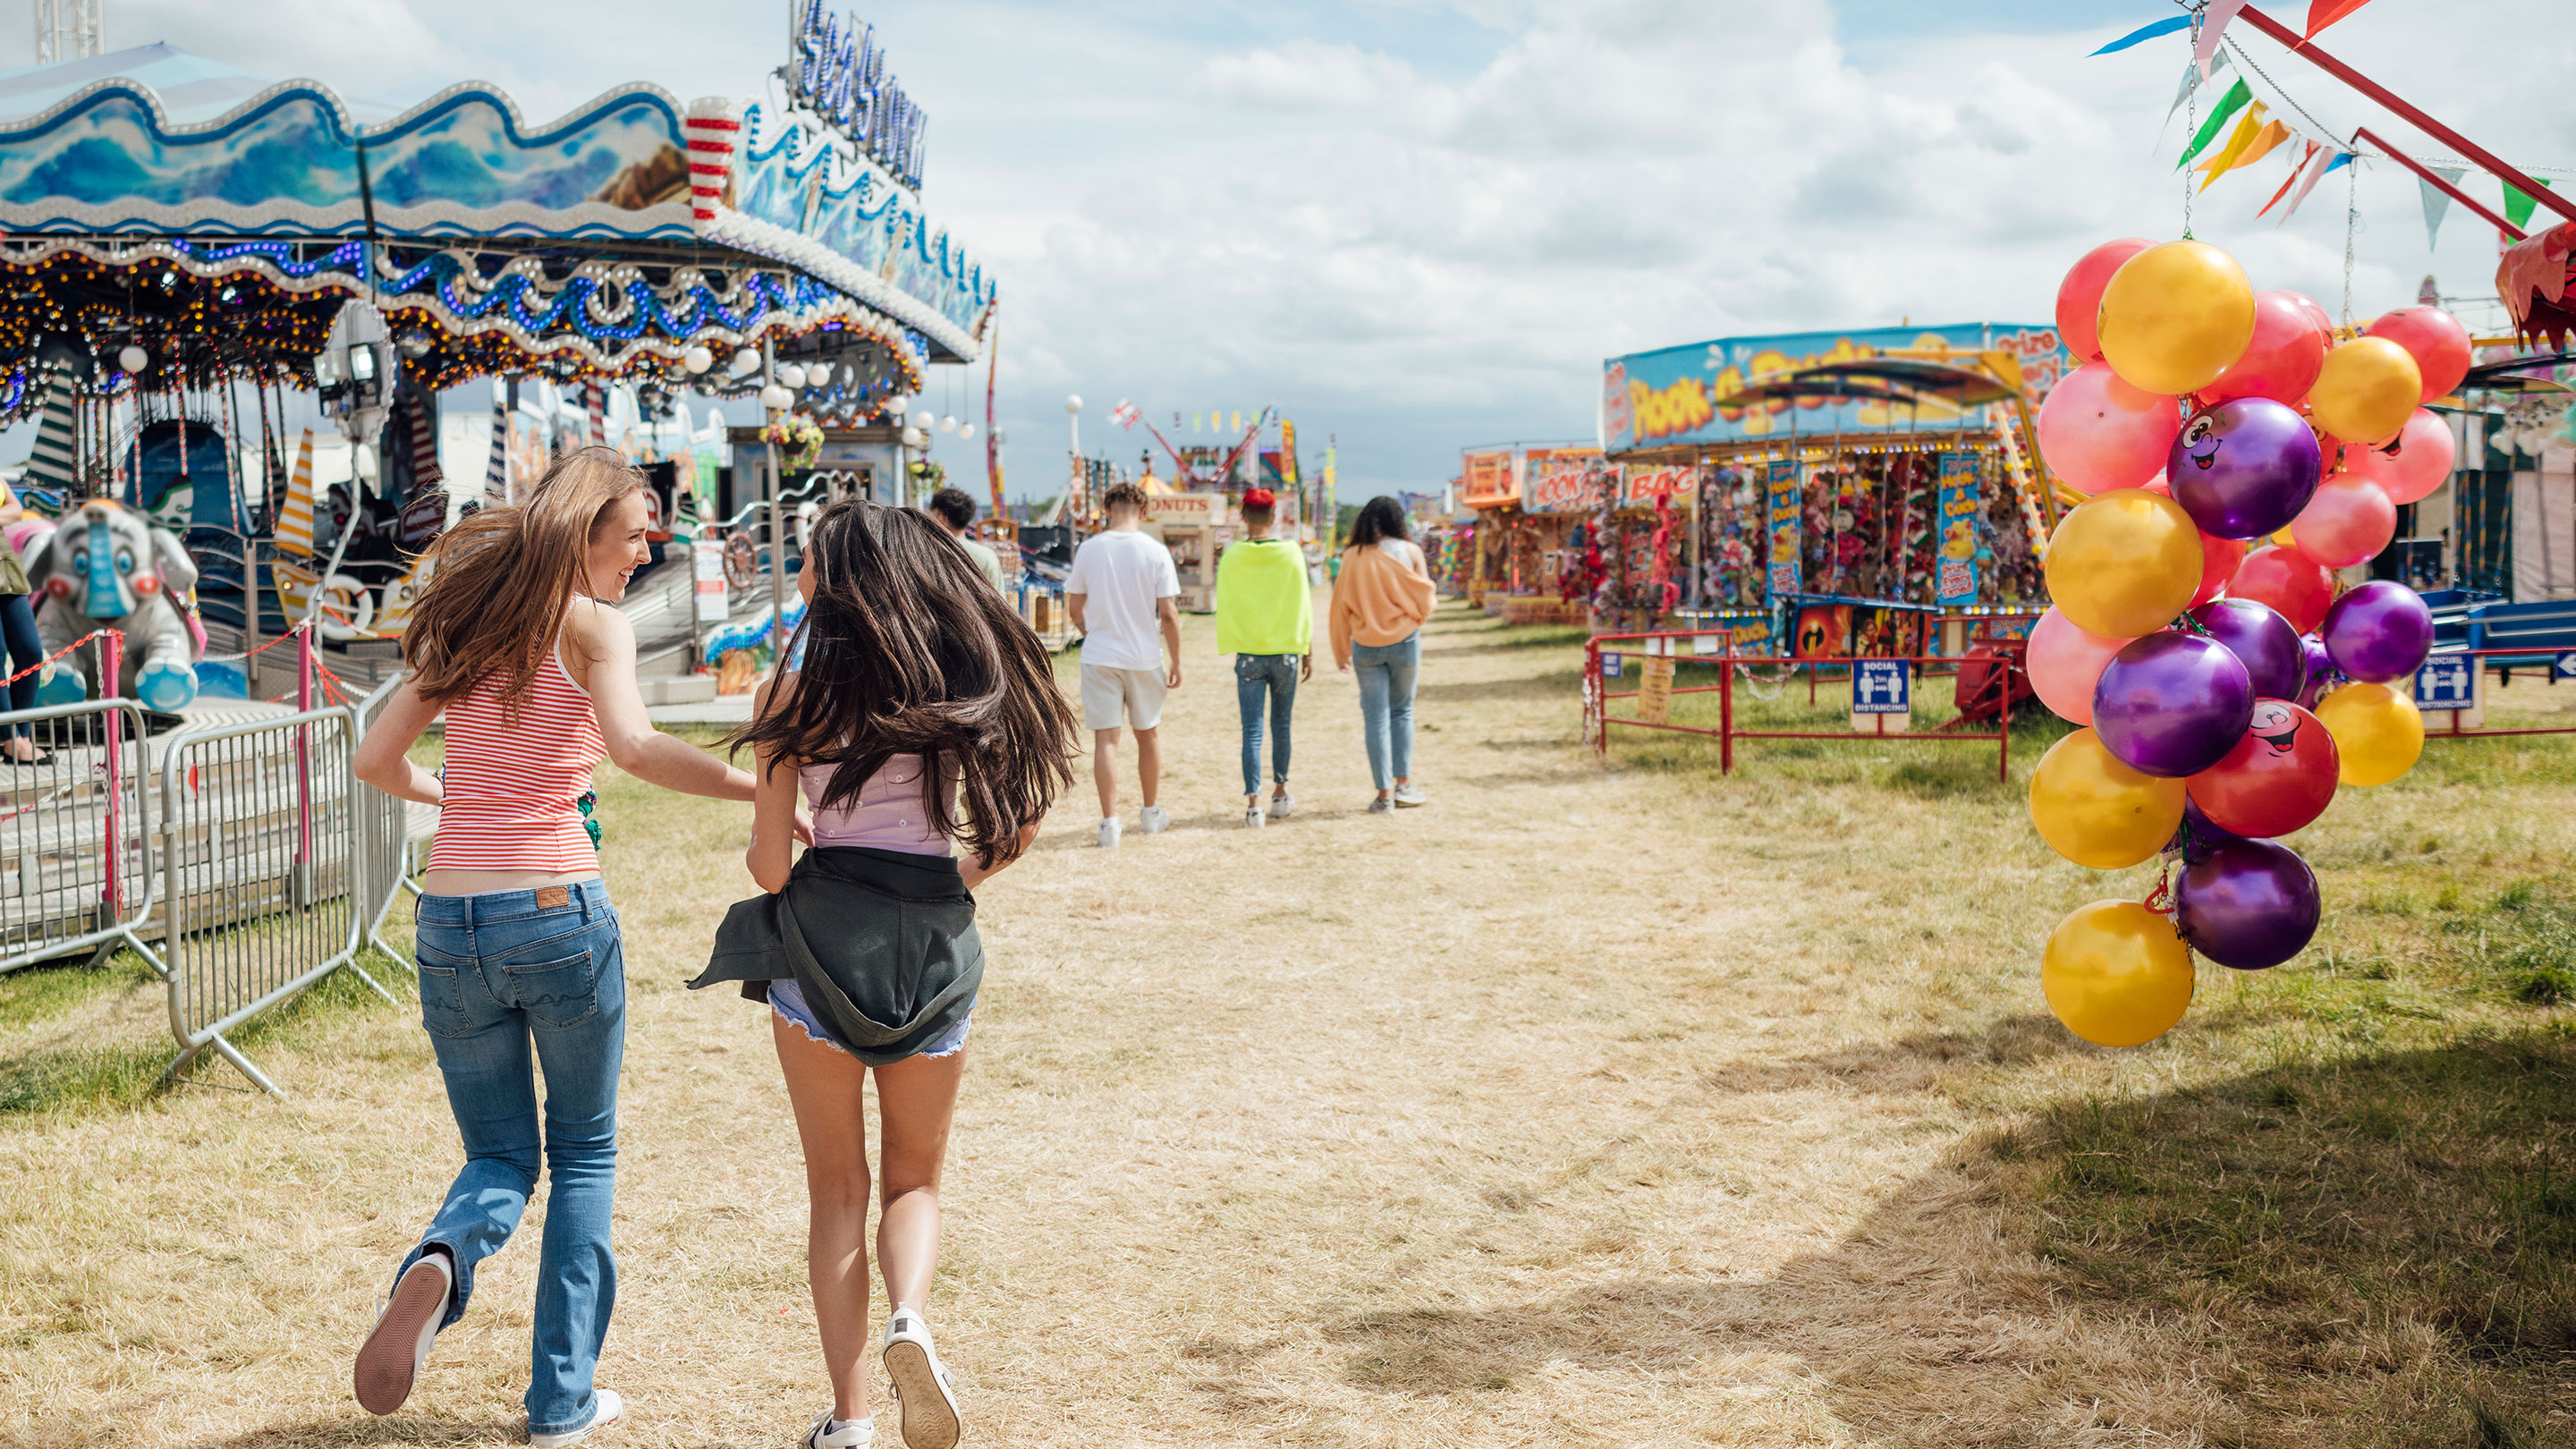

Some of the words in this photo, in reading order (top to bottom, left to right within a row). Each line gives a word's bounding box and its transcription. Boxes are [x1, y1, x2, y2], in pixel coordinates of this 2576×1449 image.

[1631, 467, 1693, 501] BAG
[1863, 662, 1898, 671] SOCIAL
[1855, 703, 1908, 712] DISTANCING
